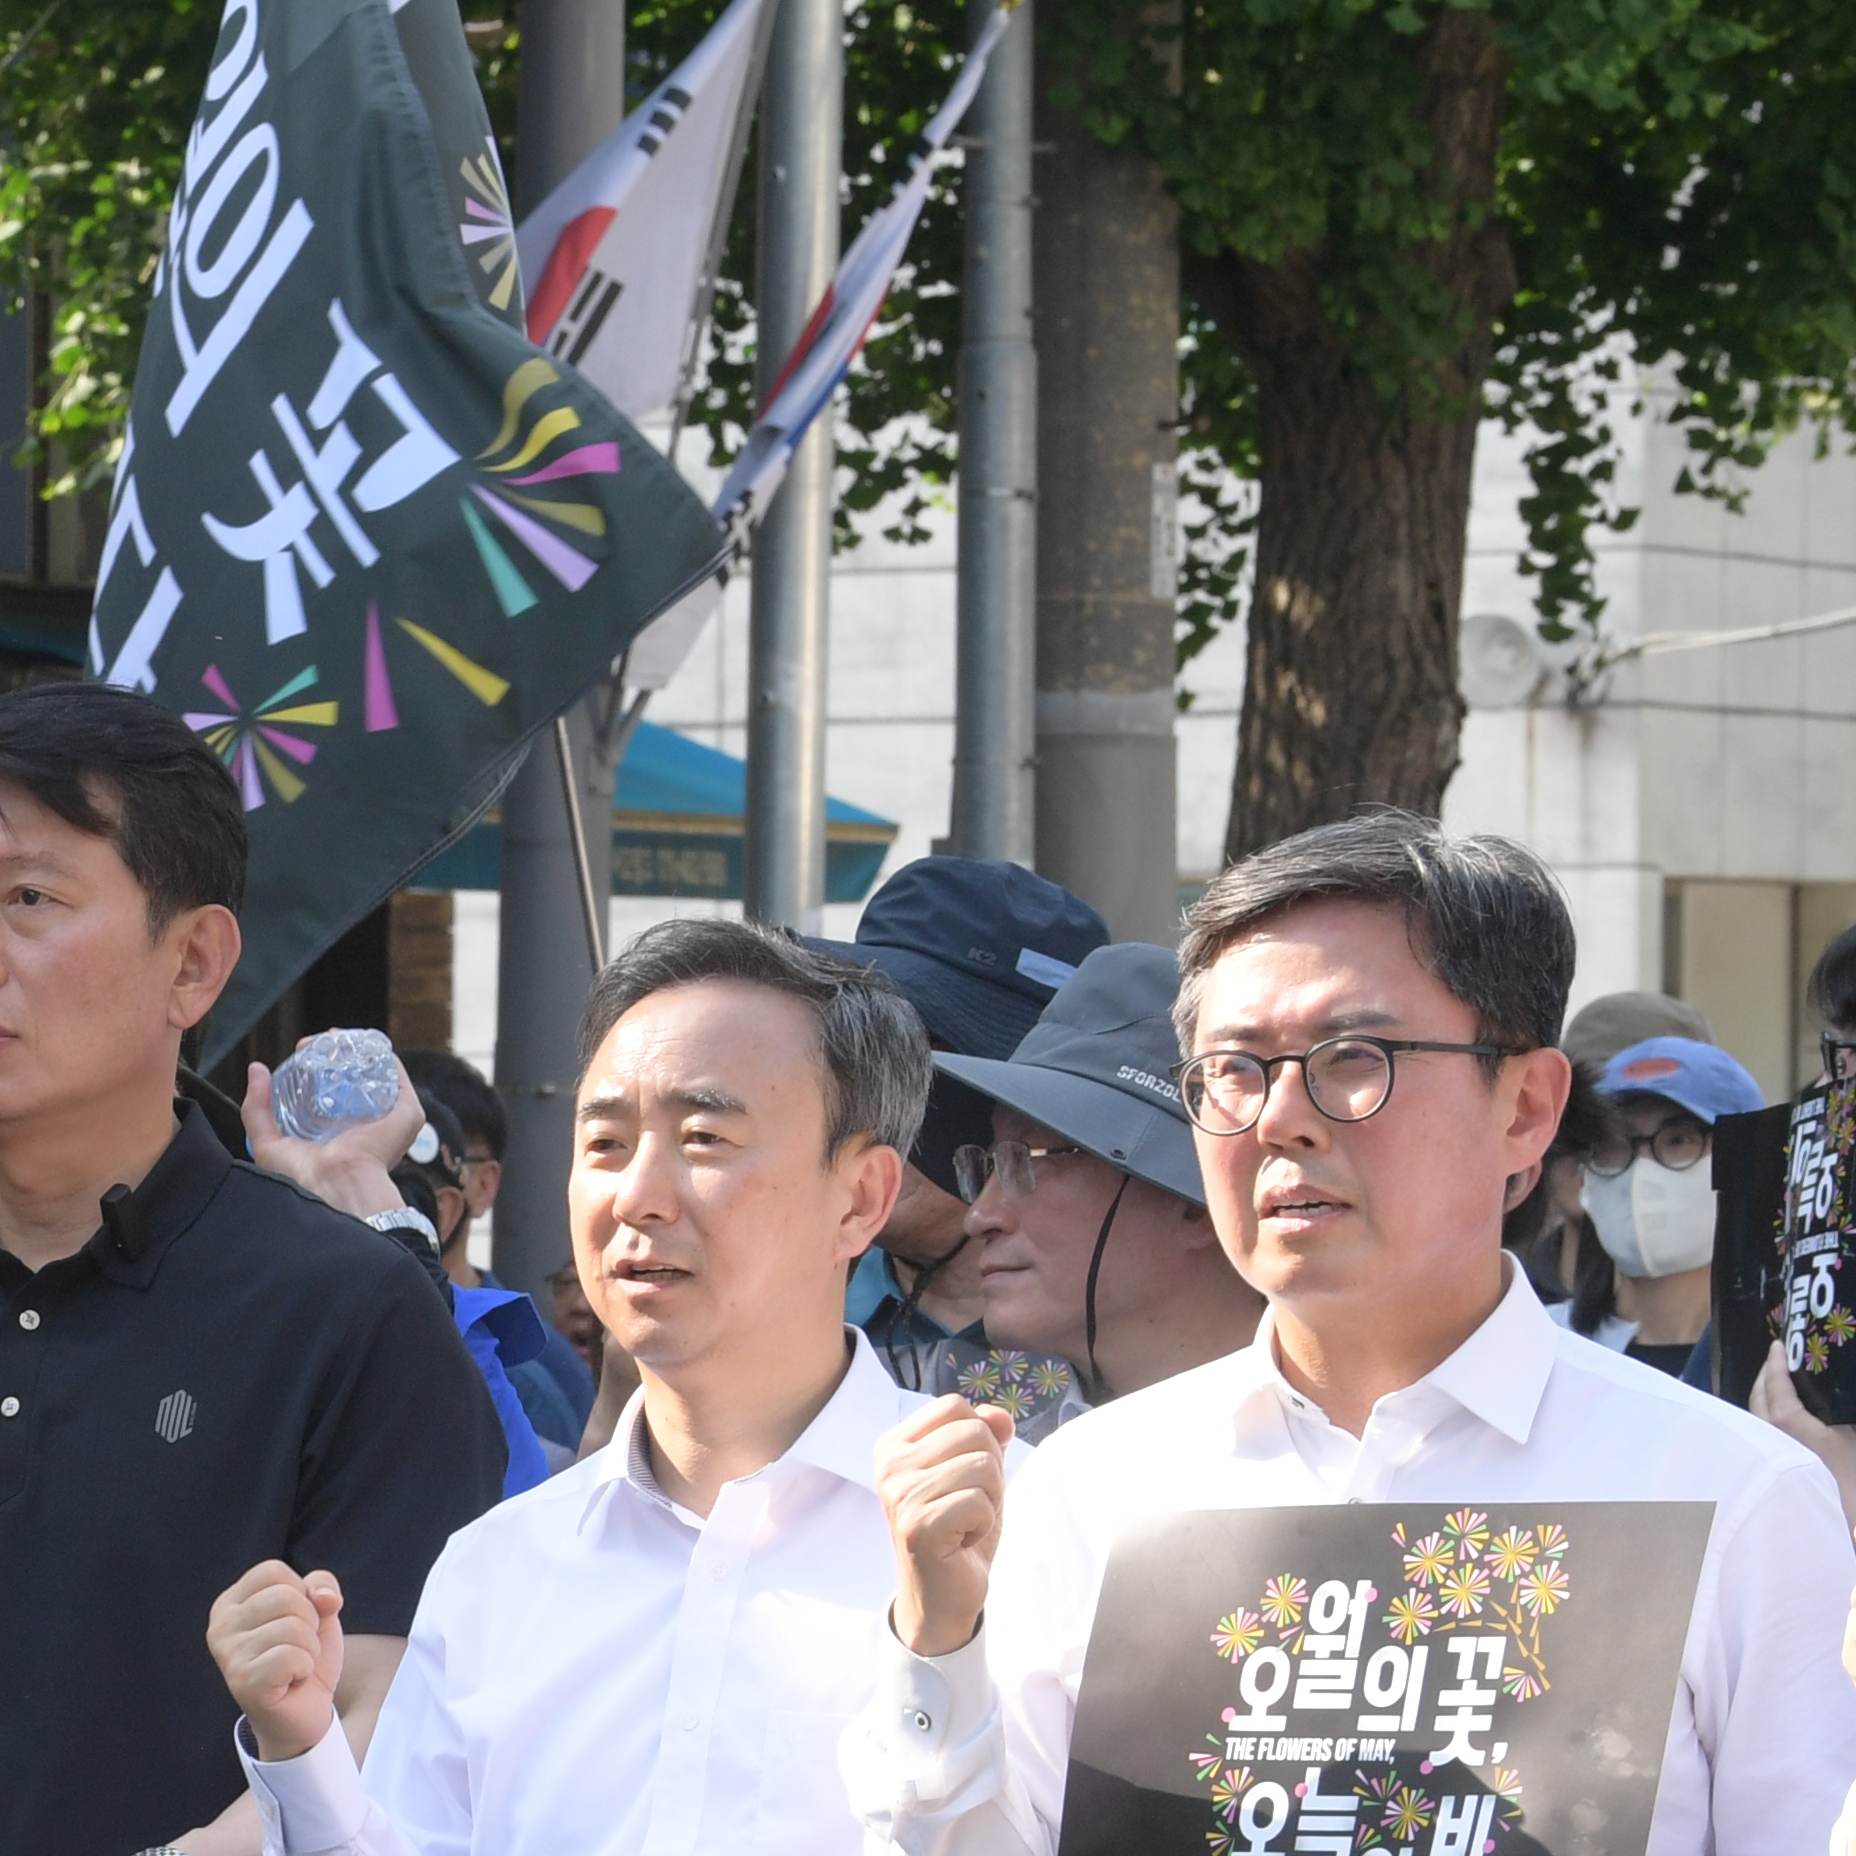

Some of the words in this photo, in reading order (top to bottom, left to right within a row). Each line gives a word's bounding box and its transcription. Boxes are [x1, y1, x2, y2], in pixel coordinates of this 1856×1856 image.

[1227, 1579, 1429, 1732] 오월의
[1427, 1635, 1509, 1767] 꽃,
[1224, 1736, 1258, 1762] THE
[1257, 1737, 1334, 1762] FLOWERS
[1333, 1738, 1356, 1762] OF
[1358, 1738, 1397, 1765] MAY,
